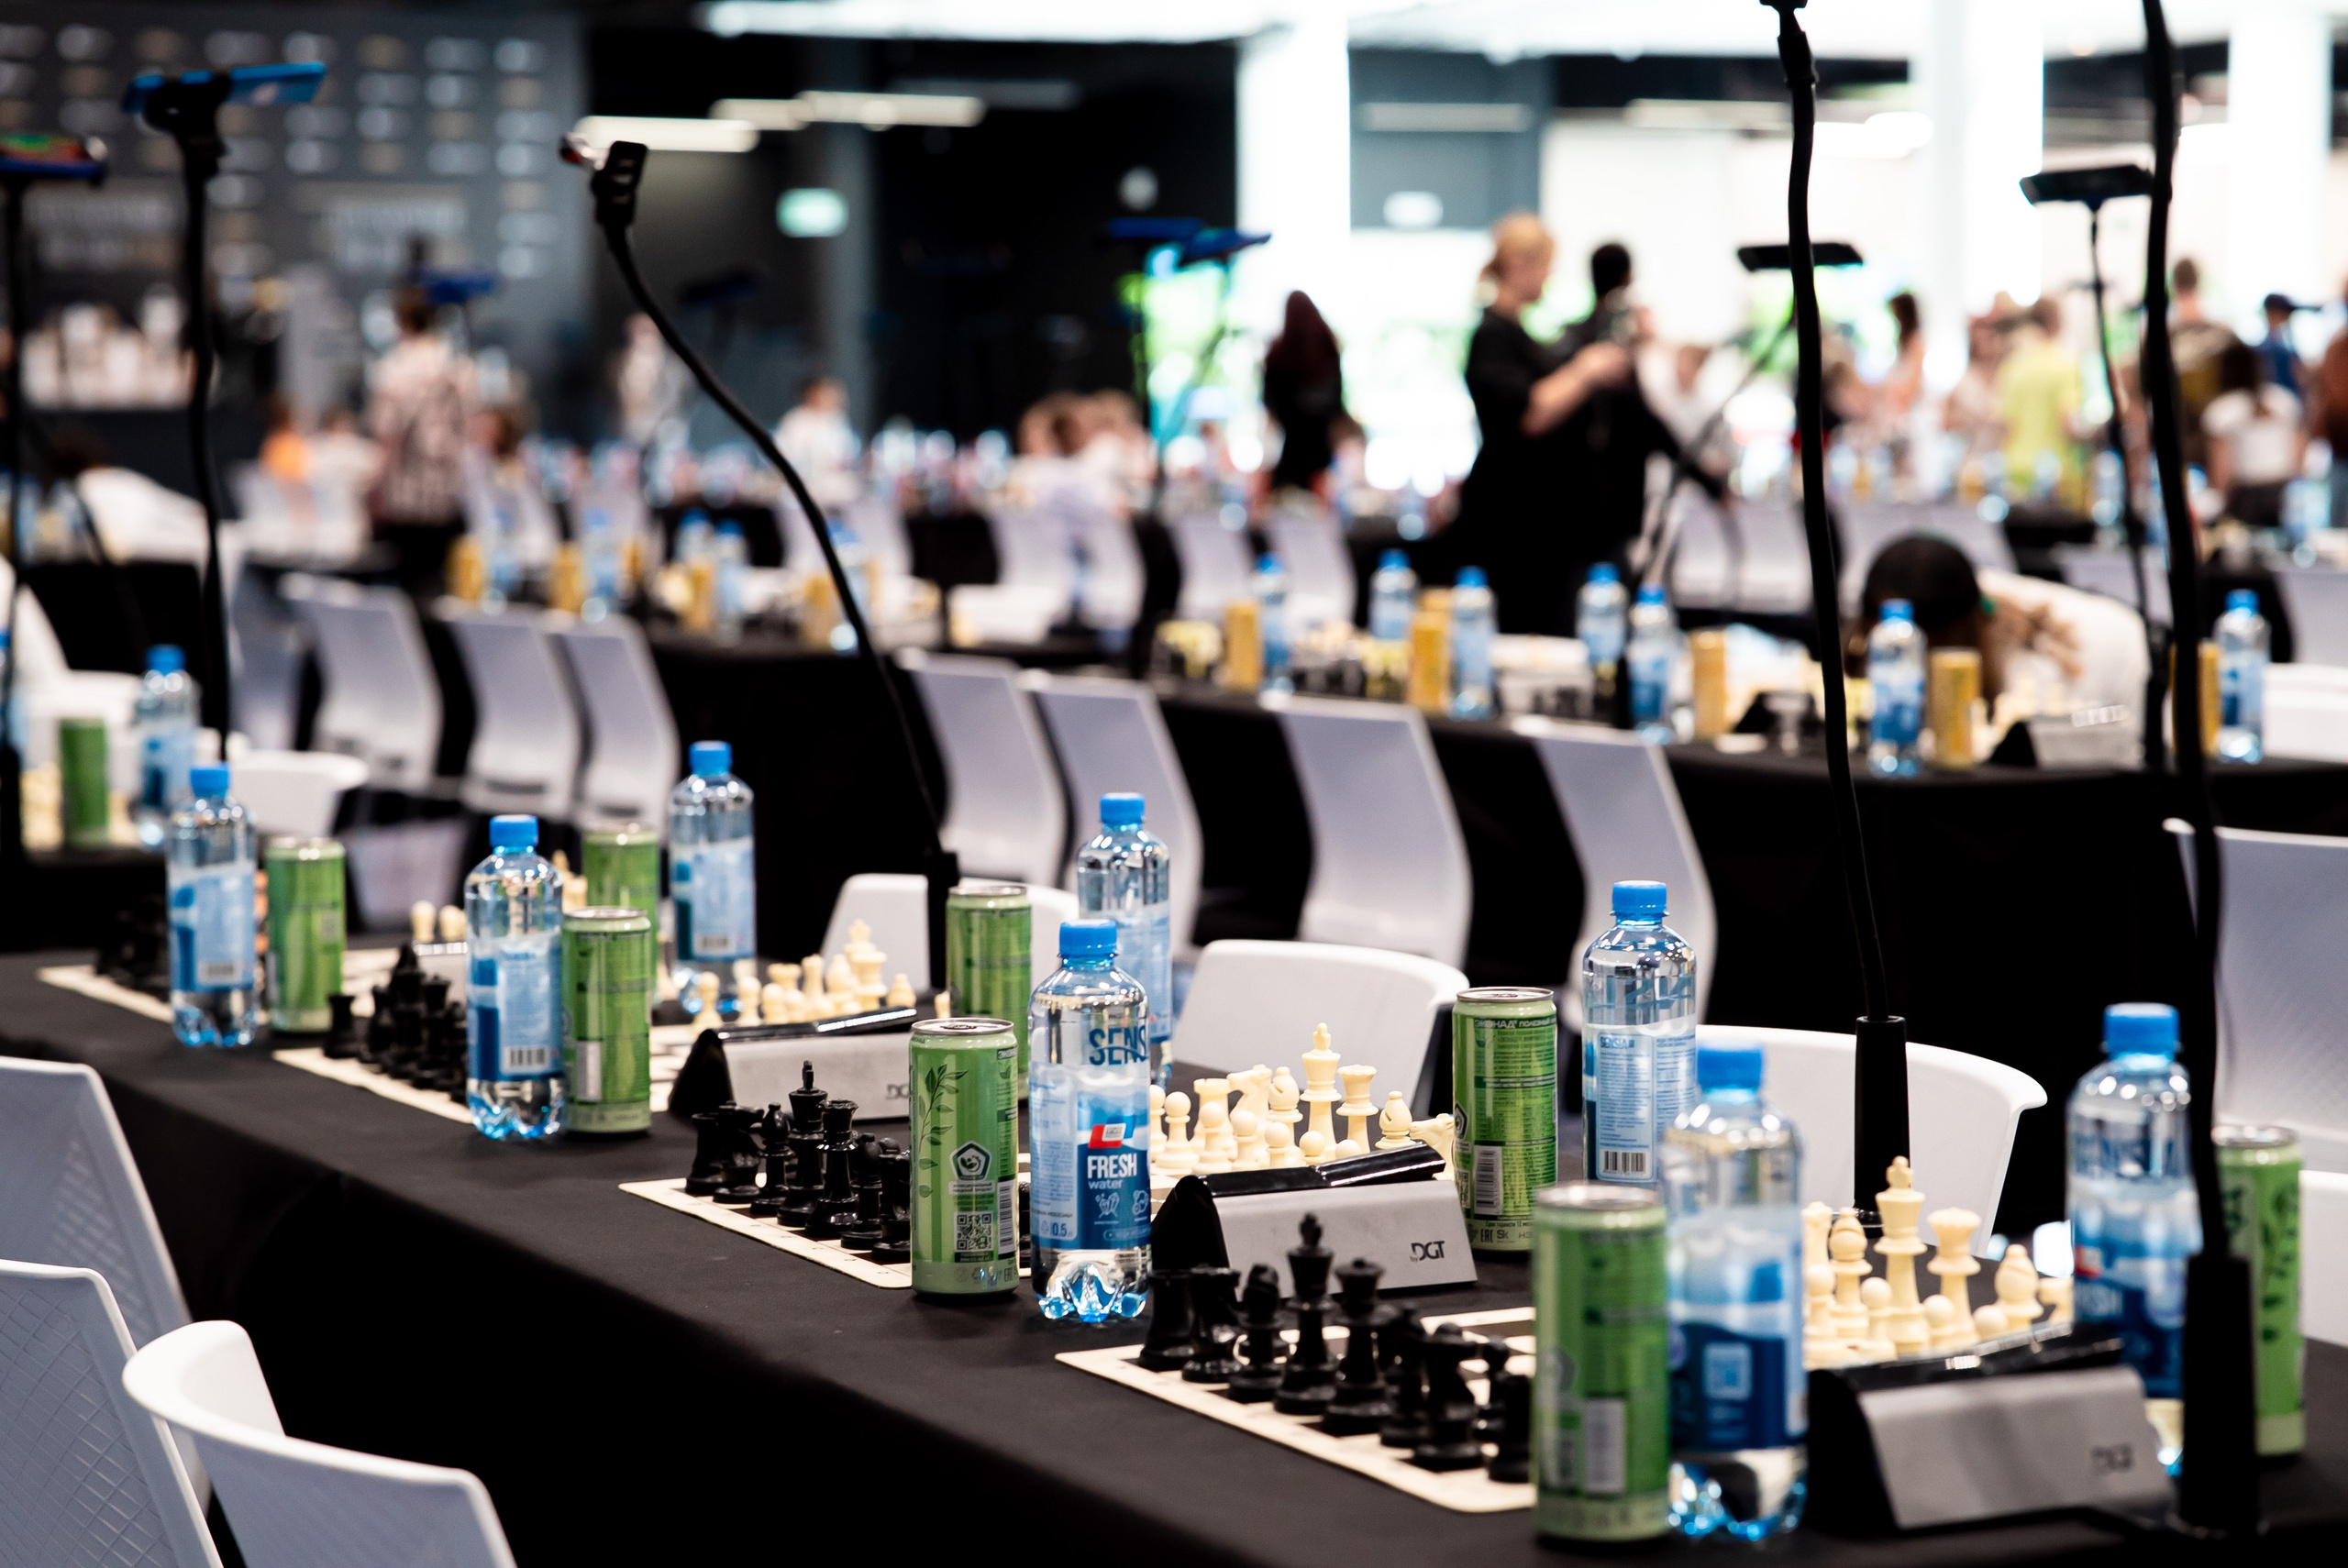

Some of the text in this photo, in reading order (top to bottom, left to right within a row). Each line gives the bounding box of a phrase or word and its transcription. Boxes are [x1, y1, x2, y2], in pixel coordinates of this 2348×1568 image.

[1087, 1153, 1137, 1179] FRESH
[1088, 1178, 1124, 1190] water
[1411, 1240, 1445, 1262] DGT
